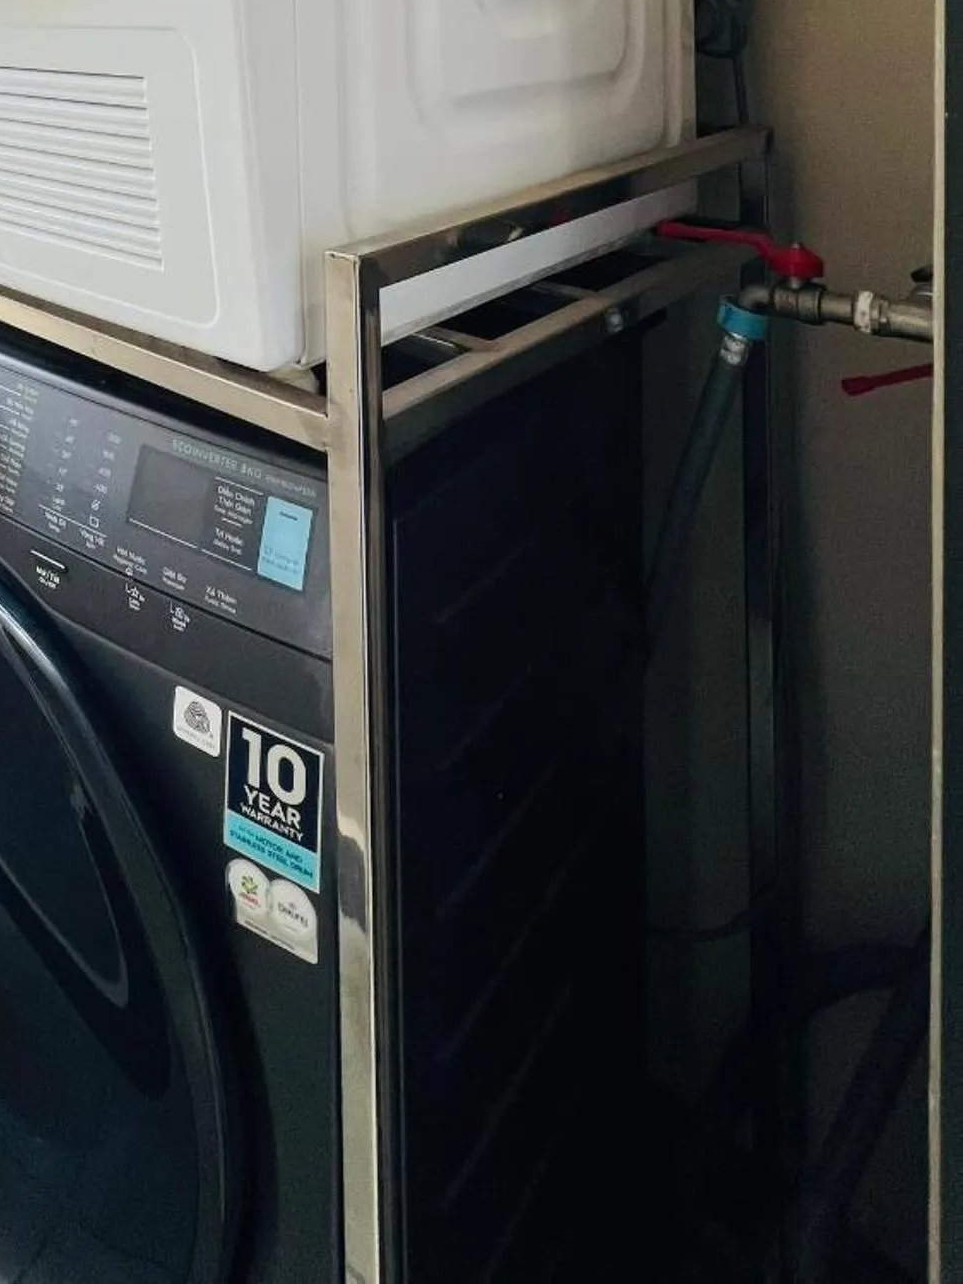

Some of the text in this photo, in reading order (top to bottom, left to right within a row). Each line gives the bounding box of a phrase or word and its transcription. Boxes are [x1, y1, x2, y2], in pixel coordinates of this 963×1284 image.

[241, 727, 307, 806] 10
[239, 801, 304, 843] WARRANTY
[243, 784, 302, 830] YEAR
